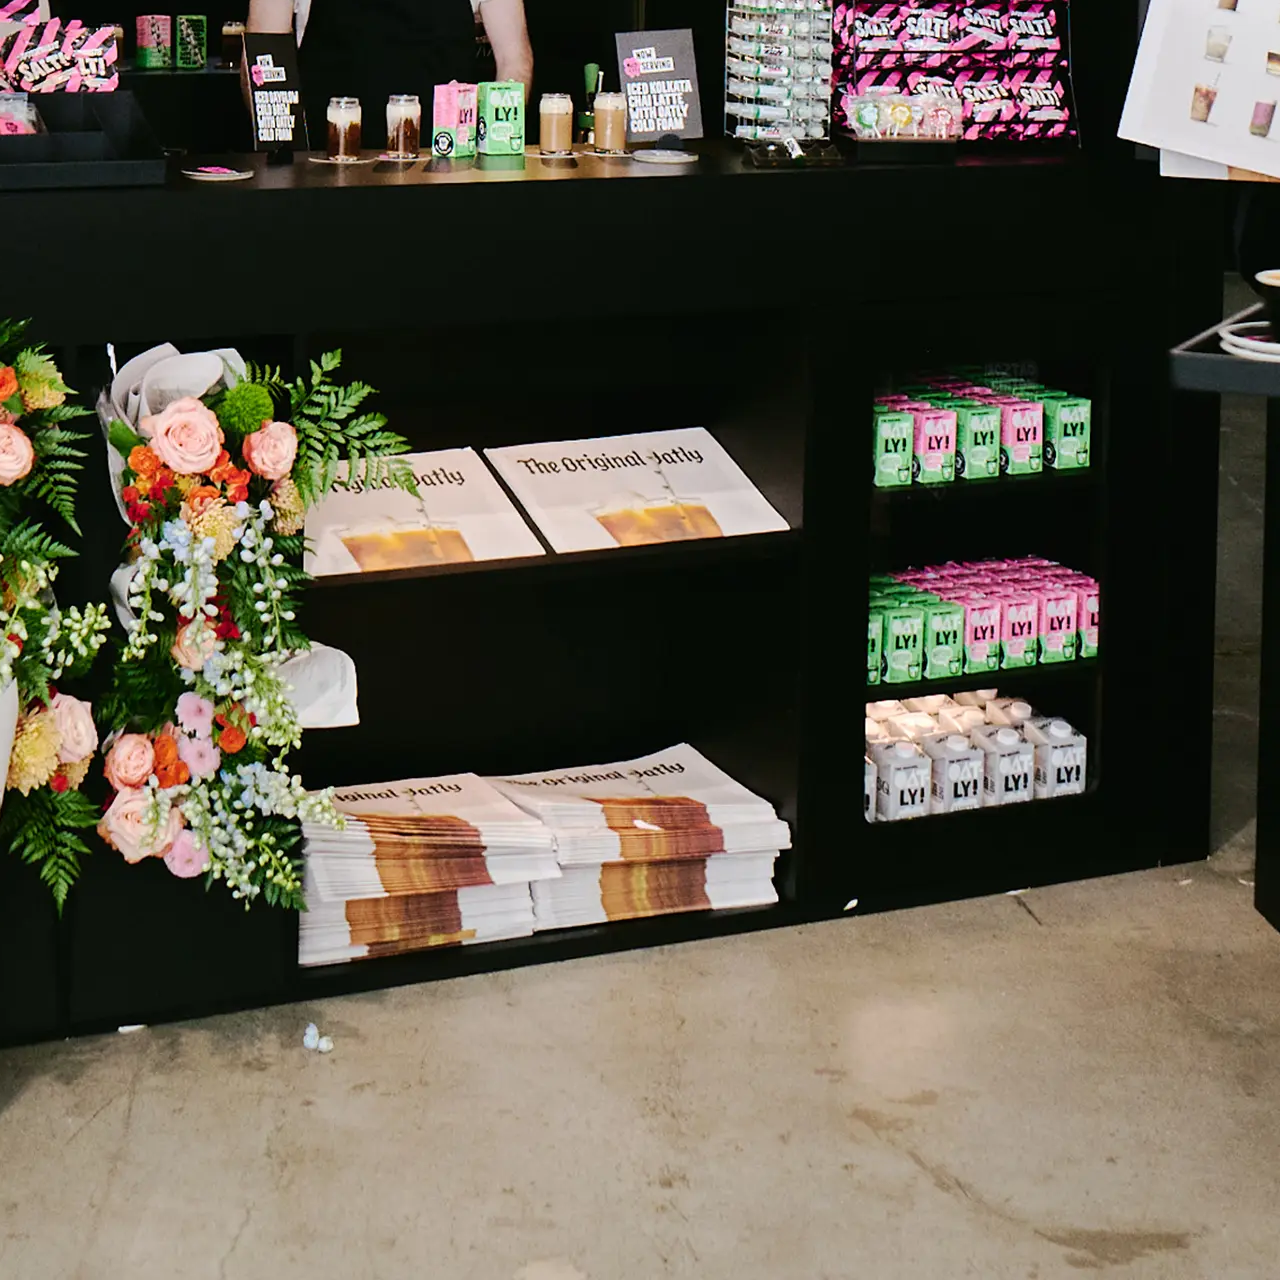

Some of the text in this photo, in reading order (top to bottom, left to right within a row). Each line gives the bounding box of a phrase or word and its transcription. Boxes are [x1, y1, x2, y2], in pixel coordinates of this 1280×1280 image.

[906, 17, 950, 39] SALT!
[962, 7, 1003, 33] SALT!
[1008, 17, 1053, 36] SALT!
[18, 52, 71, 82] SALT!
[627, 79, 693, 95] ICED KOLKATA
[962, 84, 1009, 102] SALT!
[628, 92, 684, 107] CHAI LATTE
[1019, 88, 1060, 107] SALT!
[460, 108, 472, 124] LY!
[495, 107, 518, 121] LY!
[629, 104, 689, 119] WITH OATLY
[631, 117, 684, 132] COLD FOAM
[1016, 426, 1037, 442] LY!
[1063, 421, 1084, 437] LY!
[884, 437, 907, 453] LY!
[928, 435, 949, 450] LY!
[974, 430, 994, 446] LY!
[517, 456, 561, 476] The
[563, 449, 644, 474] Original
[1011, 620, 1032, 636] LY!
[1050, 615, 1071, 631] LY!
[935, 630, 957, 646] LY!
[974, 625, 994, 641] LY!
[895, 634, 917, 650] LY!
[542, 771, 627, 790] Original
[1004, 773, 1028, 792] LY!
[1056, 765, 1081, 784] LY!
[899, 787, 925, 806] LY!
[953, 779, 979, 798] LY!
